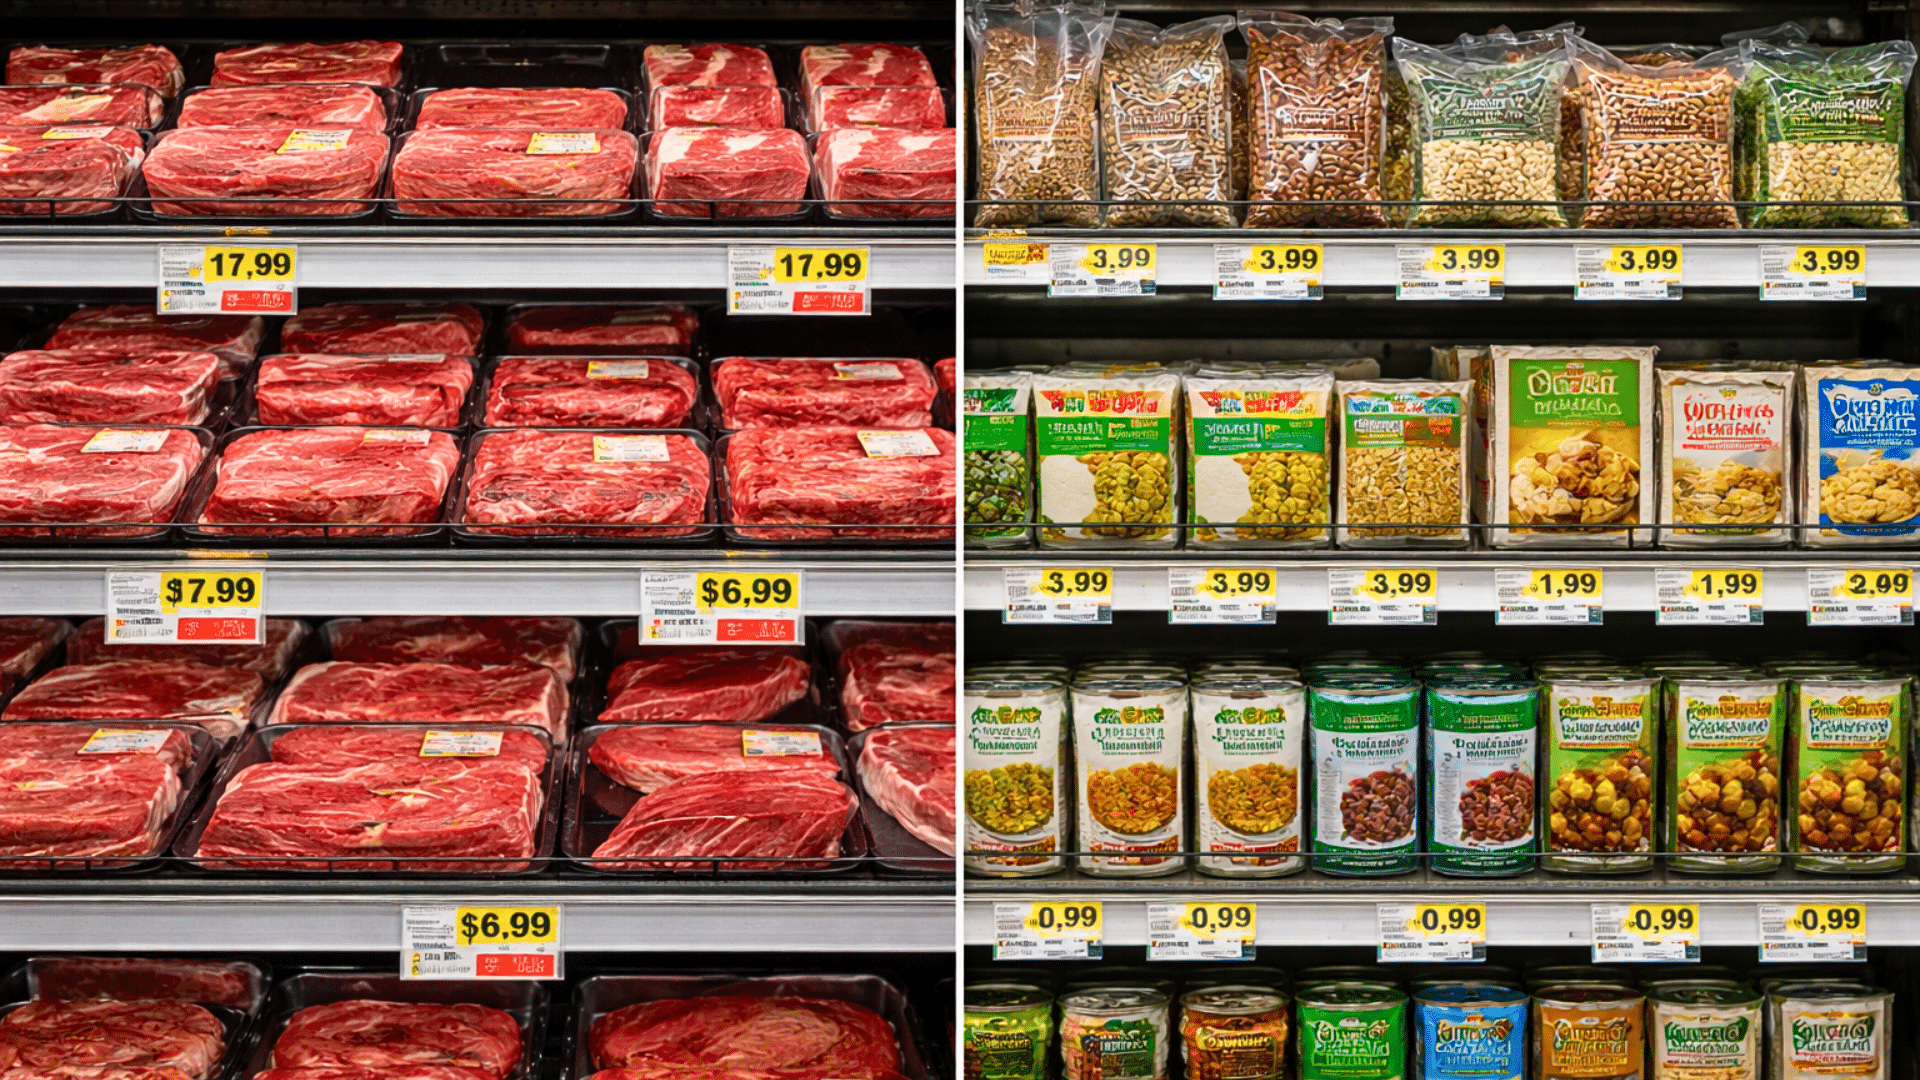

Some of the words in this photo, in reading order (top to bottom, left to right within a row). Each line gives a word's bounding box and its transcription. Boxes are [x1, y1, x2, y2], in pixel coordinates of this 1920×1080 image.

[210, 253, 291, 279] 17,99
[780, 253, 862, 279] 17,99
[702, 578, 792, 608] $6,99
